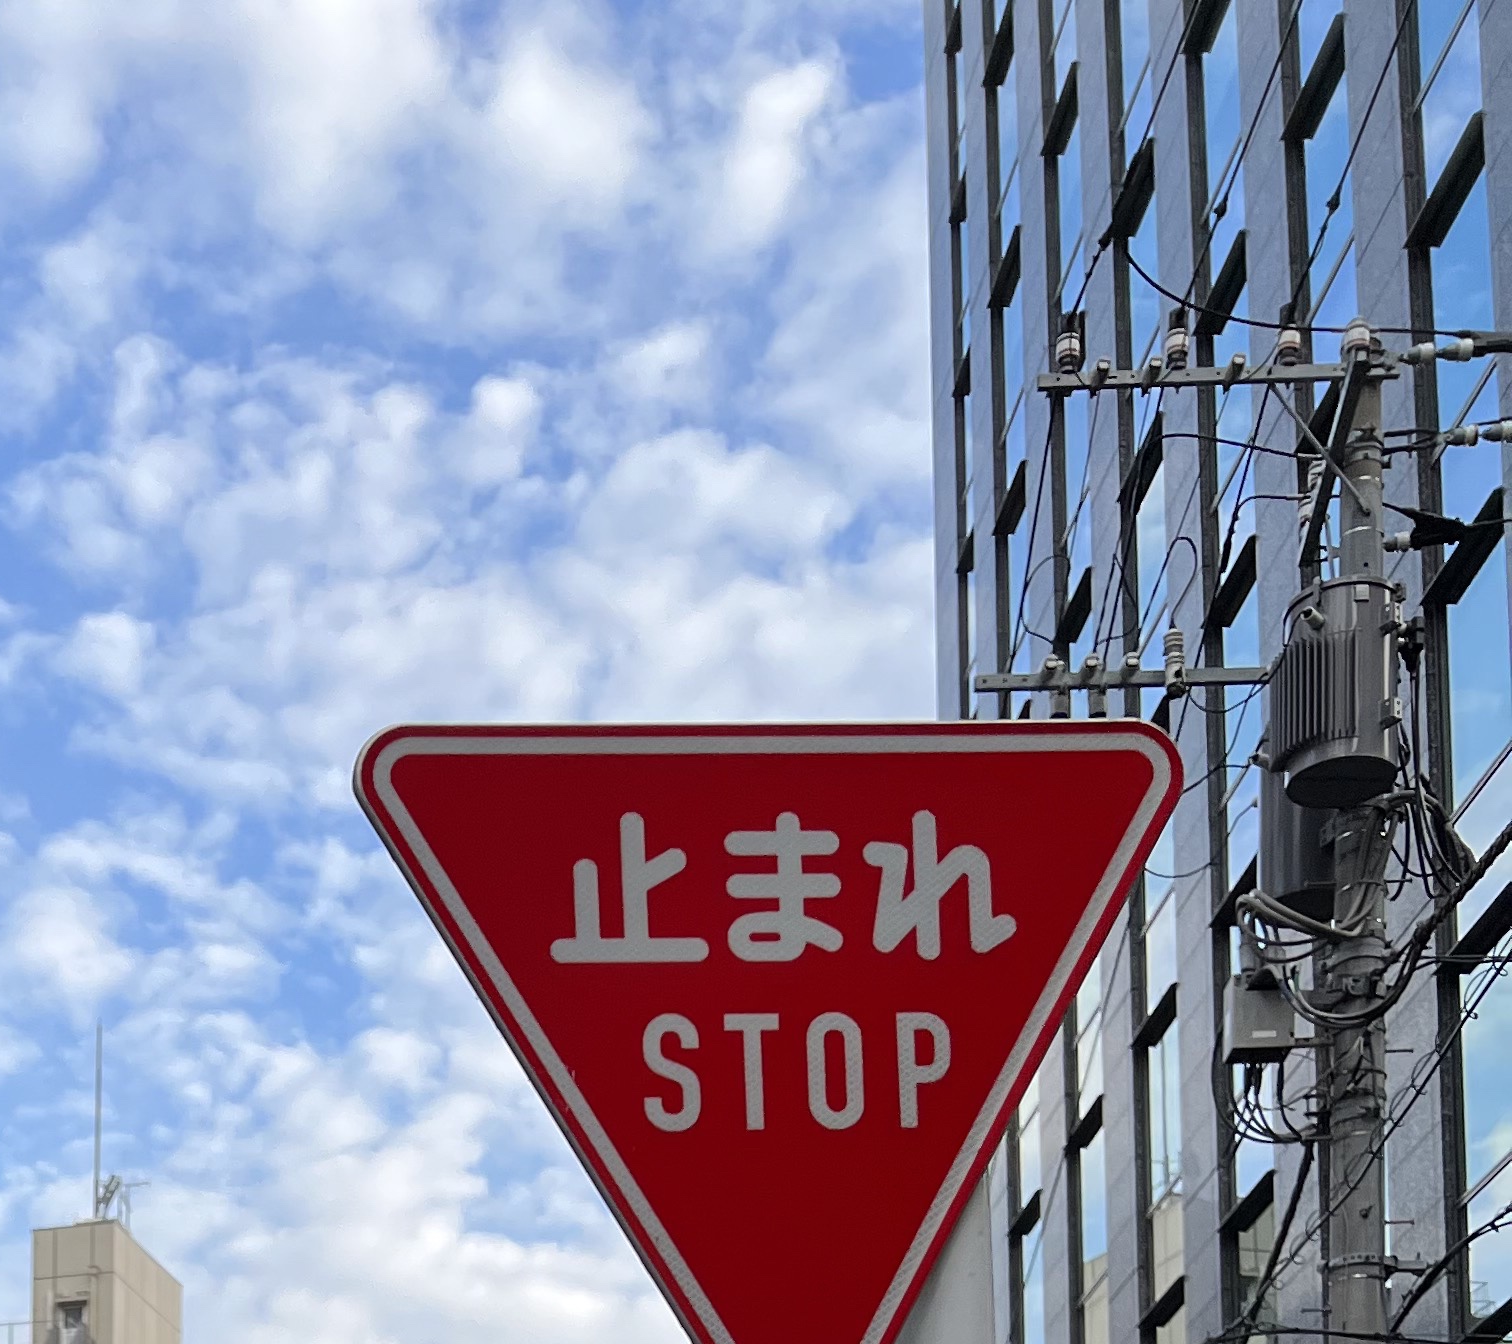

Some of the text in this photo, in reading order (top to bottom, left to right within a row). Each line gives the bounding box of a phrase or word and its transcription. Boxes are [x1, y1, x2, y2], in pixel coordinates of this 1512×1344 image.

[550, 809, 1018, 964] 止まれ
[642, 1012, 951, 1132] STOP
